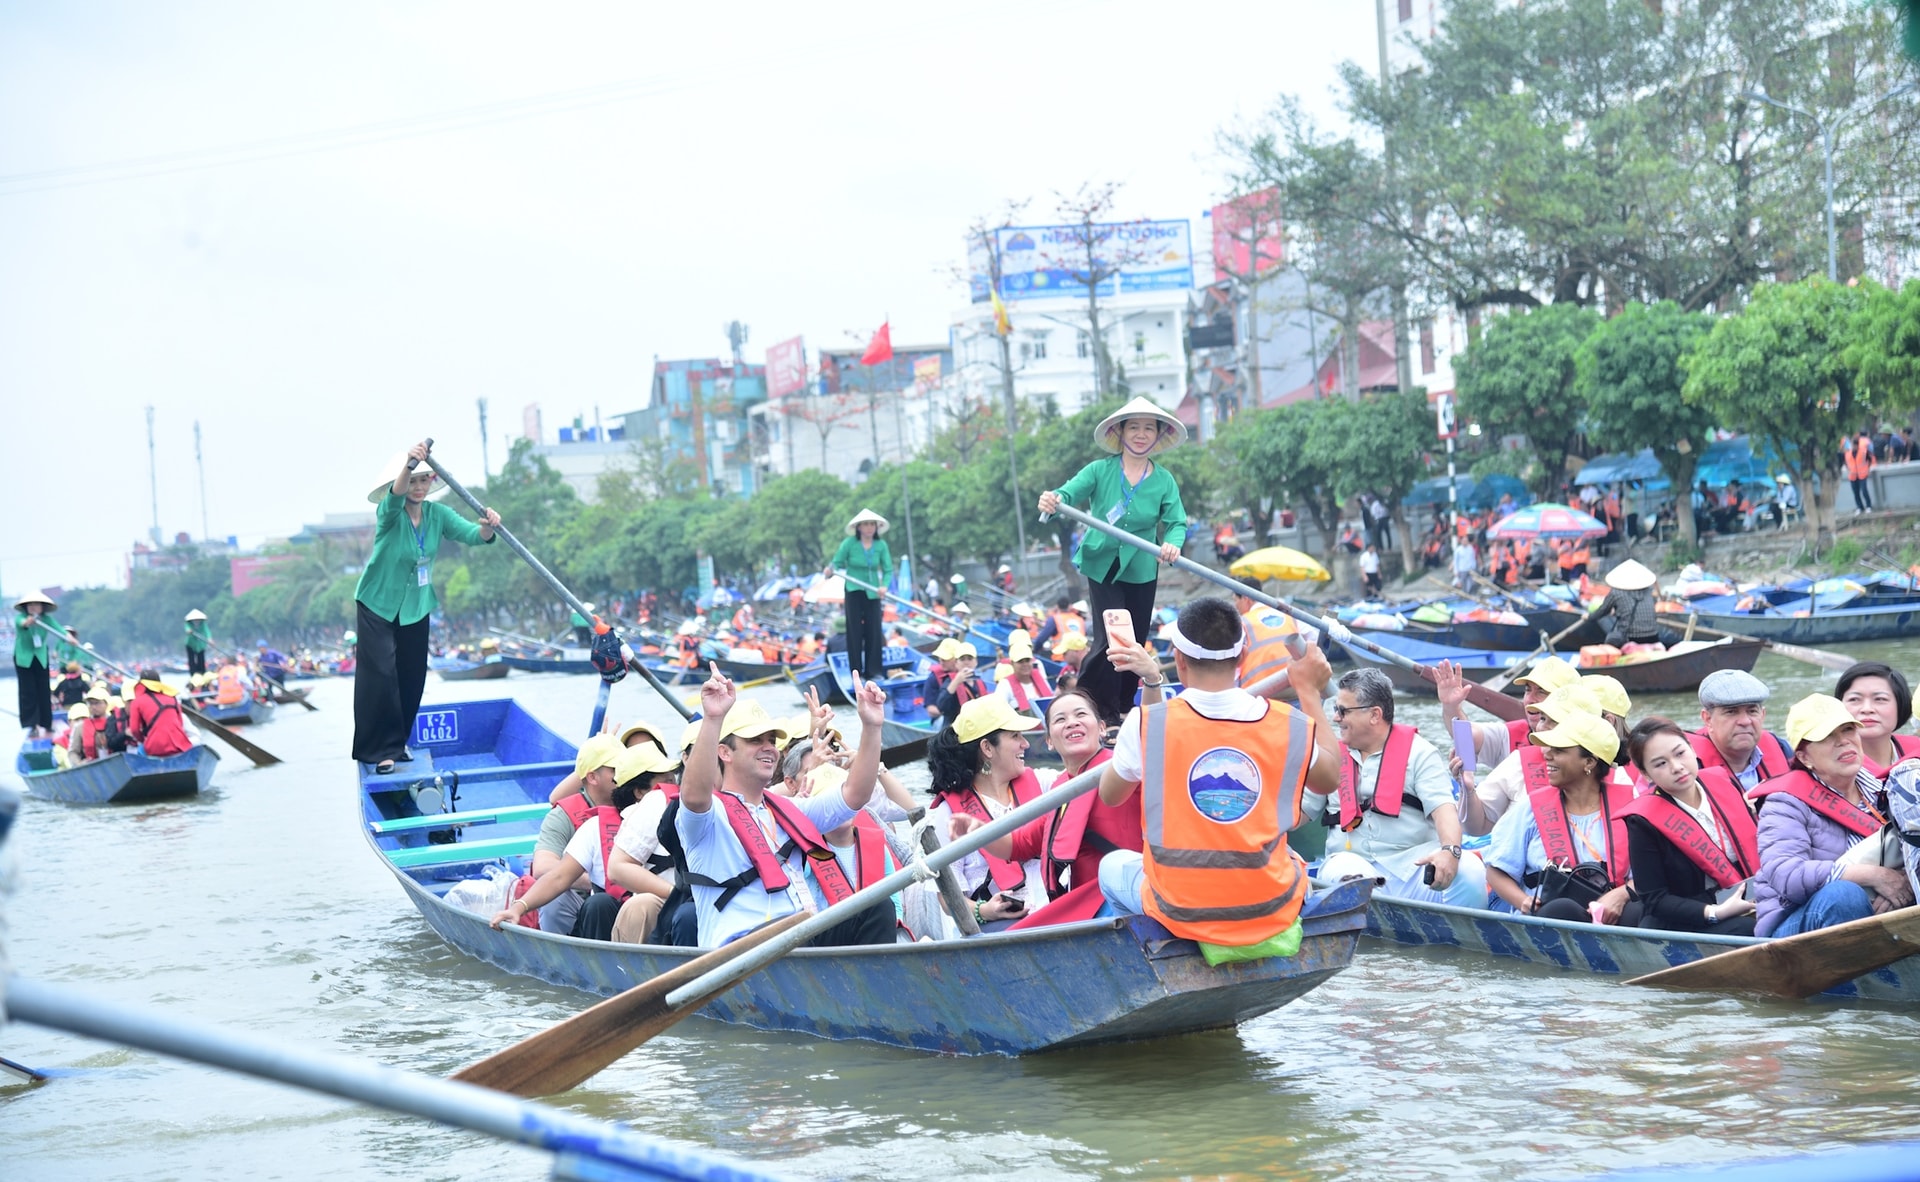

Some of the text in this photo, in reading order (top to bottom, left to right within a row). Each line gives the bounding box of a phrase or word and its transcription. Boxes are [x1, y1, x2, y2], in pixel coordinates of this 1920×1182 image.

[427, 713, 446, 727] K-2
[422, 726, 452, 741] 0402
[1808, 785, 1840, 810] LIFE
[1540, 804, 1559, 825] LIFE
[738, 814, 771, 855] JACKET
[1664, 813, 1733, 879] LIFE JACKET
